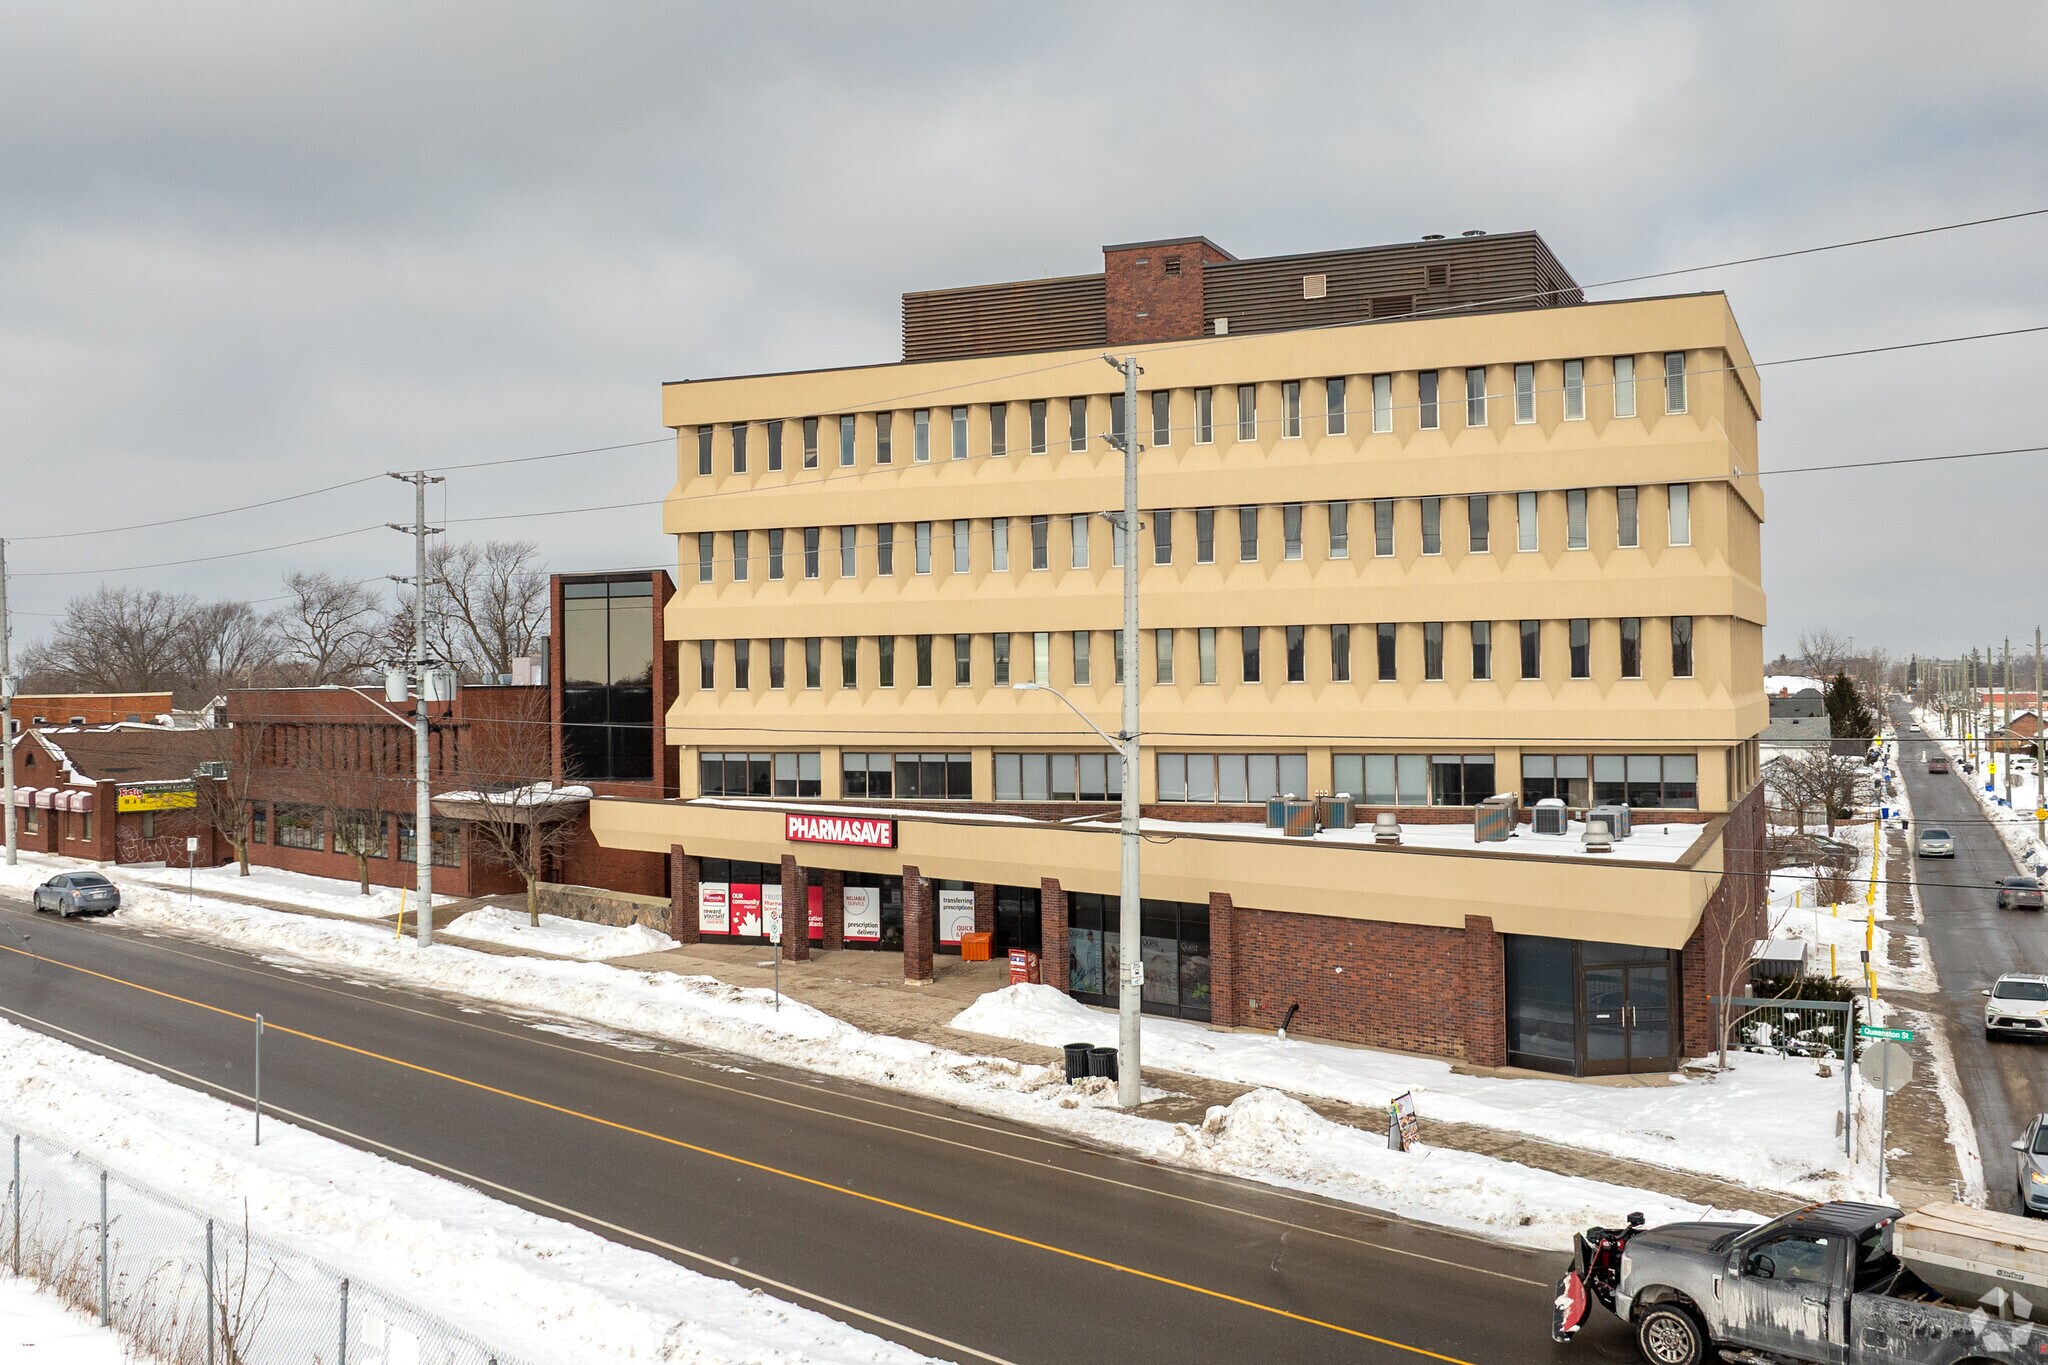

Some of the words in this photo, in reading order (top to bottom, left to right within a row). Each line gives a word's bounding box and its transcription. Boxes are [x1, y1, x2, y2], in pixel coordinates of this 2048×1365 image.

[789, 817, 889, 844] PHARMASAVE
[857, 928, 878, 936] delivery
[1864, 1027, 1900, 1038] Queenston
